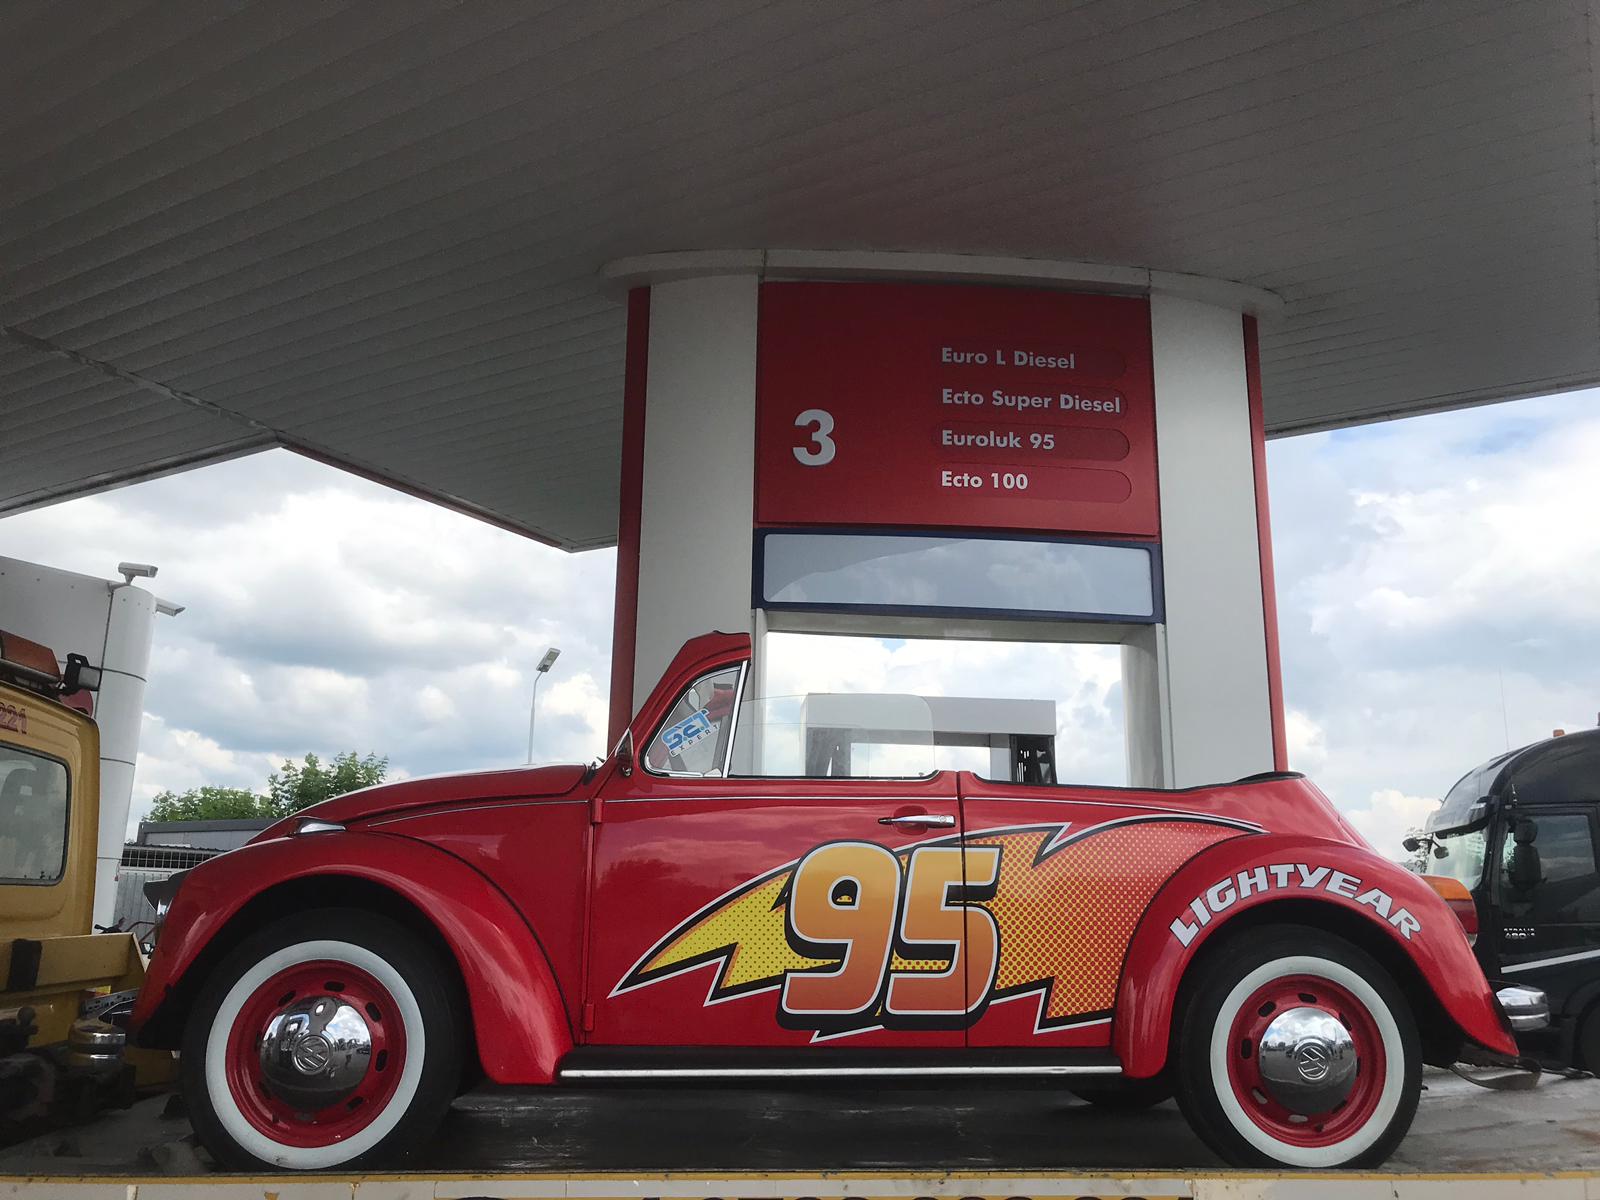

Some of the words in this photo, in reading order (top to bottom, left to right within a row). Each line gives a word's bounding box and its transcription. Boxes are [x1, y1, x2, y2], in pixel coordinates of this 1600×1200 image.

[941, 347, 988, 364] Euro
[996, 350, 1006, 365] L
[1014, 350, 1075, 369] Diesel
[941, 388, 984, 405] Ecto
[991, 390, 1052, 411] Super
[1059, 393, 1121, 414] Diesel
[792, 408, 836, 466] 3
[941, 429, 1022, 448] Euroluk
[1029, 433, 1055, 450] 95
[941, 470, 983, 488] Ecto
[991, 472, 1029, 490] 100
[670, 724, 720, 756] EXPERT
[1169, 863, 1421, 948] LIGHTYEAR
[778, 840, 1002, 1024] 95
